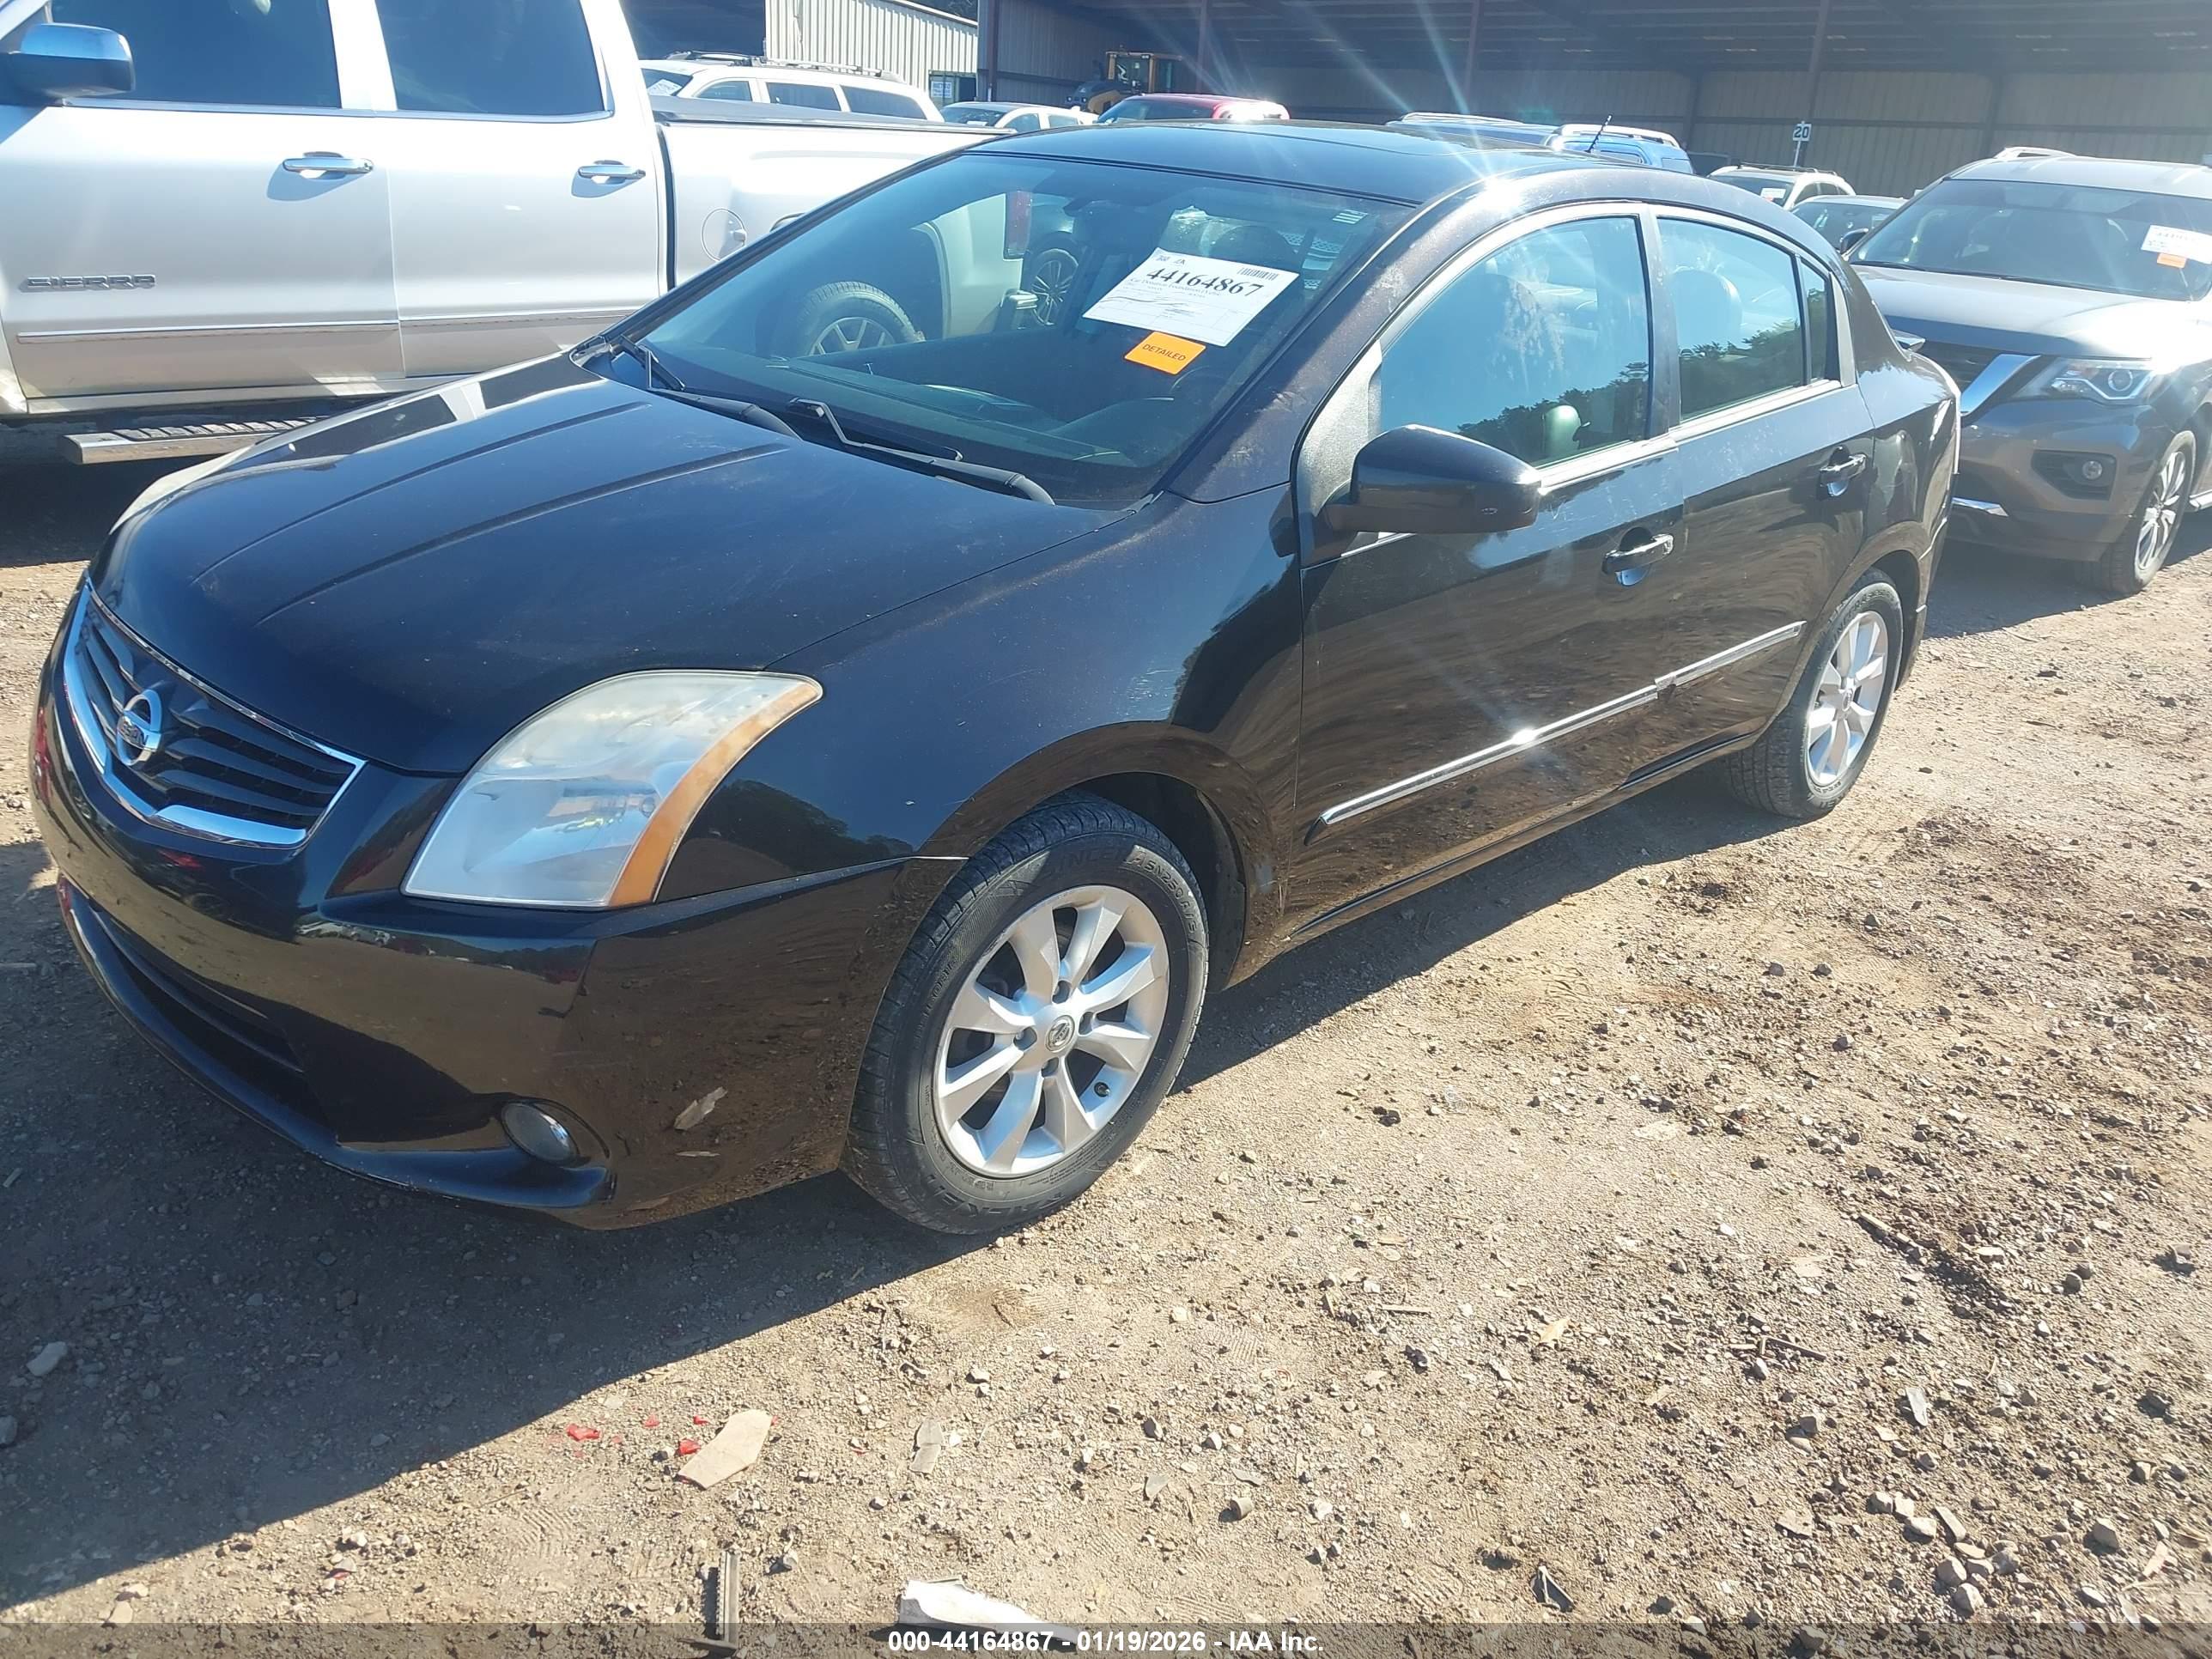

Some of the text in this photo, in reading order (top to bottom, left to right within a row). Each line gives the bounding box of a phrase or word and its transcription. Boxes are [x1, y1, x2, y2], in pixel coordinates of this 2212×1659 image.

[1795, 126, 1808, 137] 20
[27, 274, 156, 288] SIERRA
[1147, 267, 1264, 297] 44164867
[1143, 343, 1186, 362] DETAILED
[1145, 858, 1184, 901] SN250
